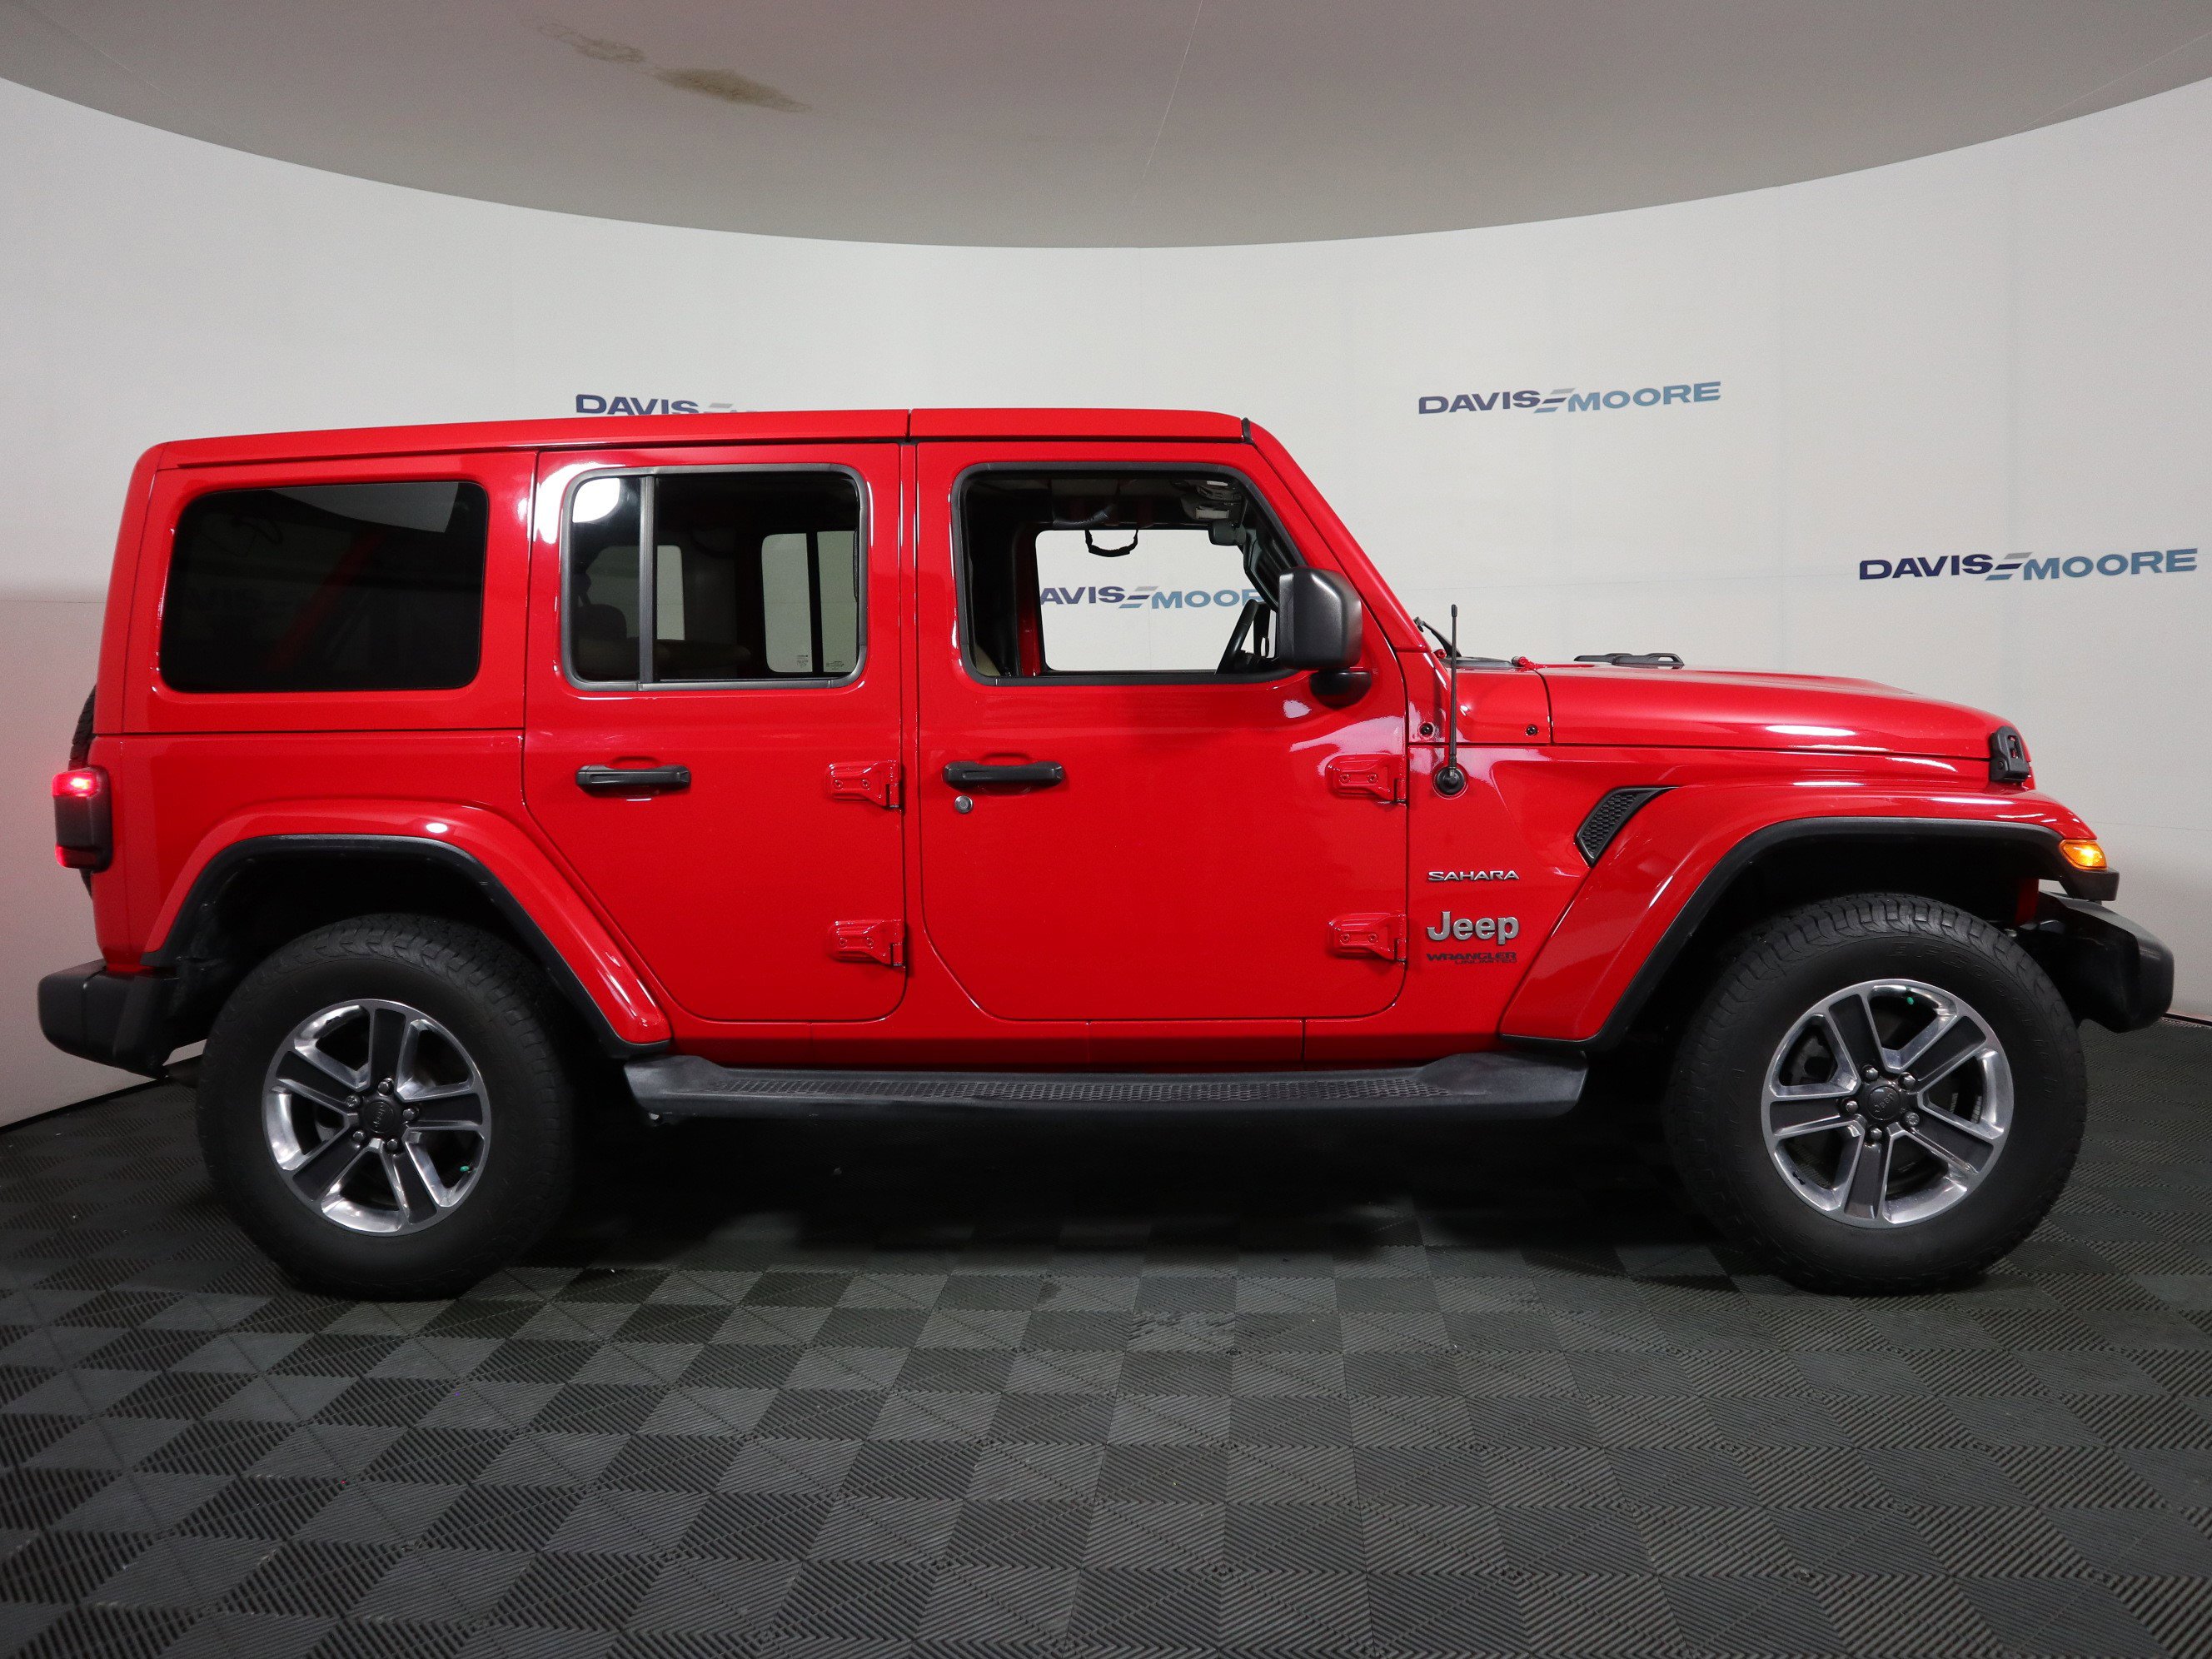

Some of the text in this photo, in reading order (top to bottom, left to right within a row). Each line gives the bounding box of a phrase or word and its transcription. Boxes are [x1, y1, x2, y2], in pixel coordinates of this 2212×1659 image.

[575, 394, 700, 416] DAVIS
[1418, 381, 1721, 414] DAVIS MOORE
[1859, 548, 2199, 581] DAVIS MOORE
[1039, 586, 1265, 610] AVIS MOO
[1427, 870, 1520, 881] SAHARA
[1427, 910, 1520, 946] Jeep
[1427, 952, 1517, 961] WRANGLER
